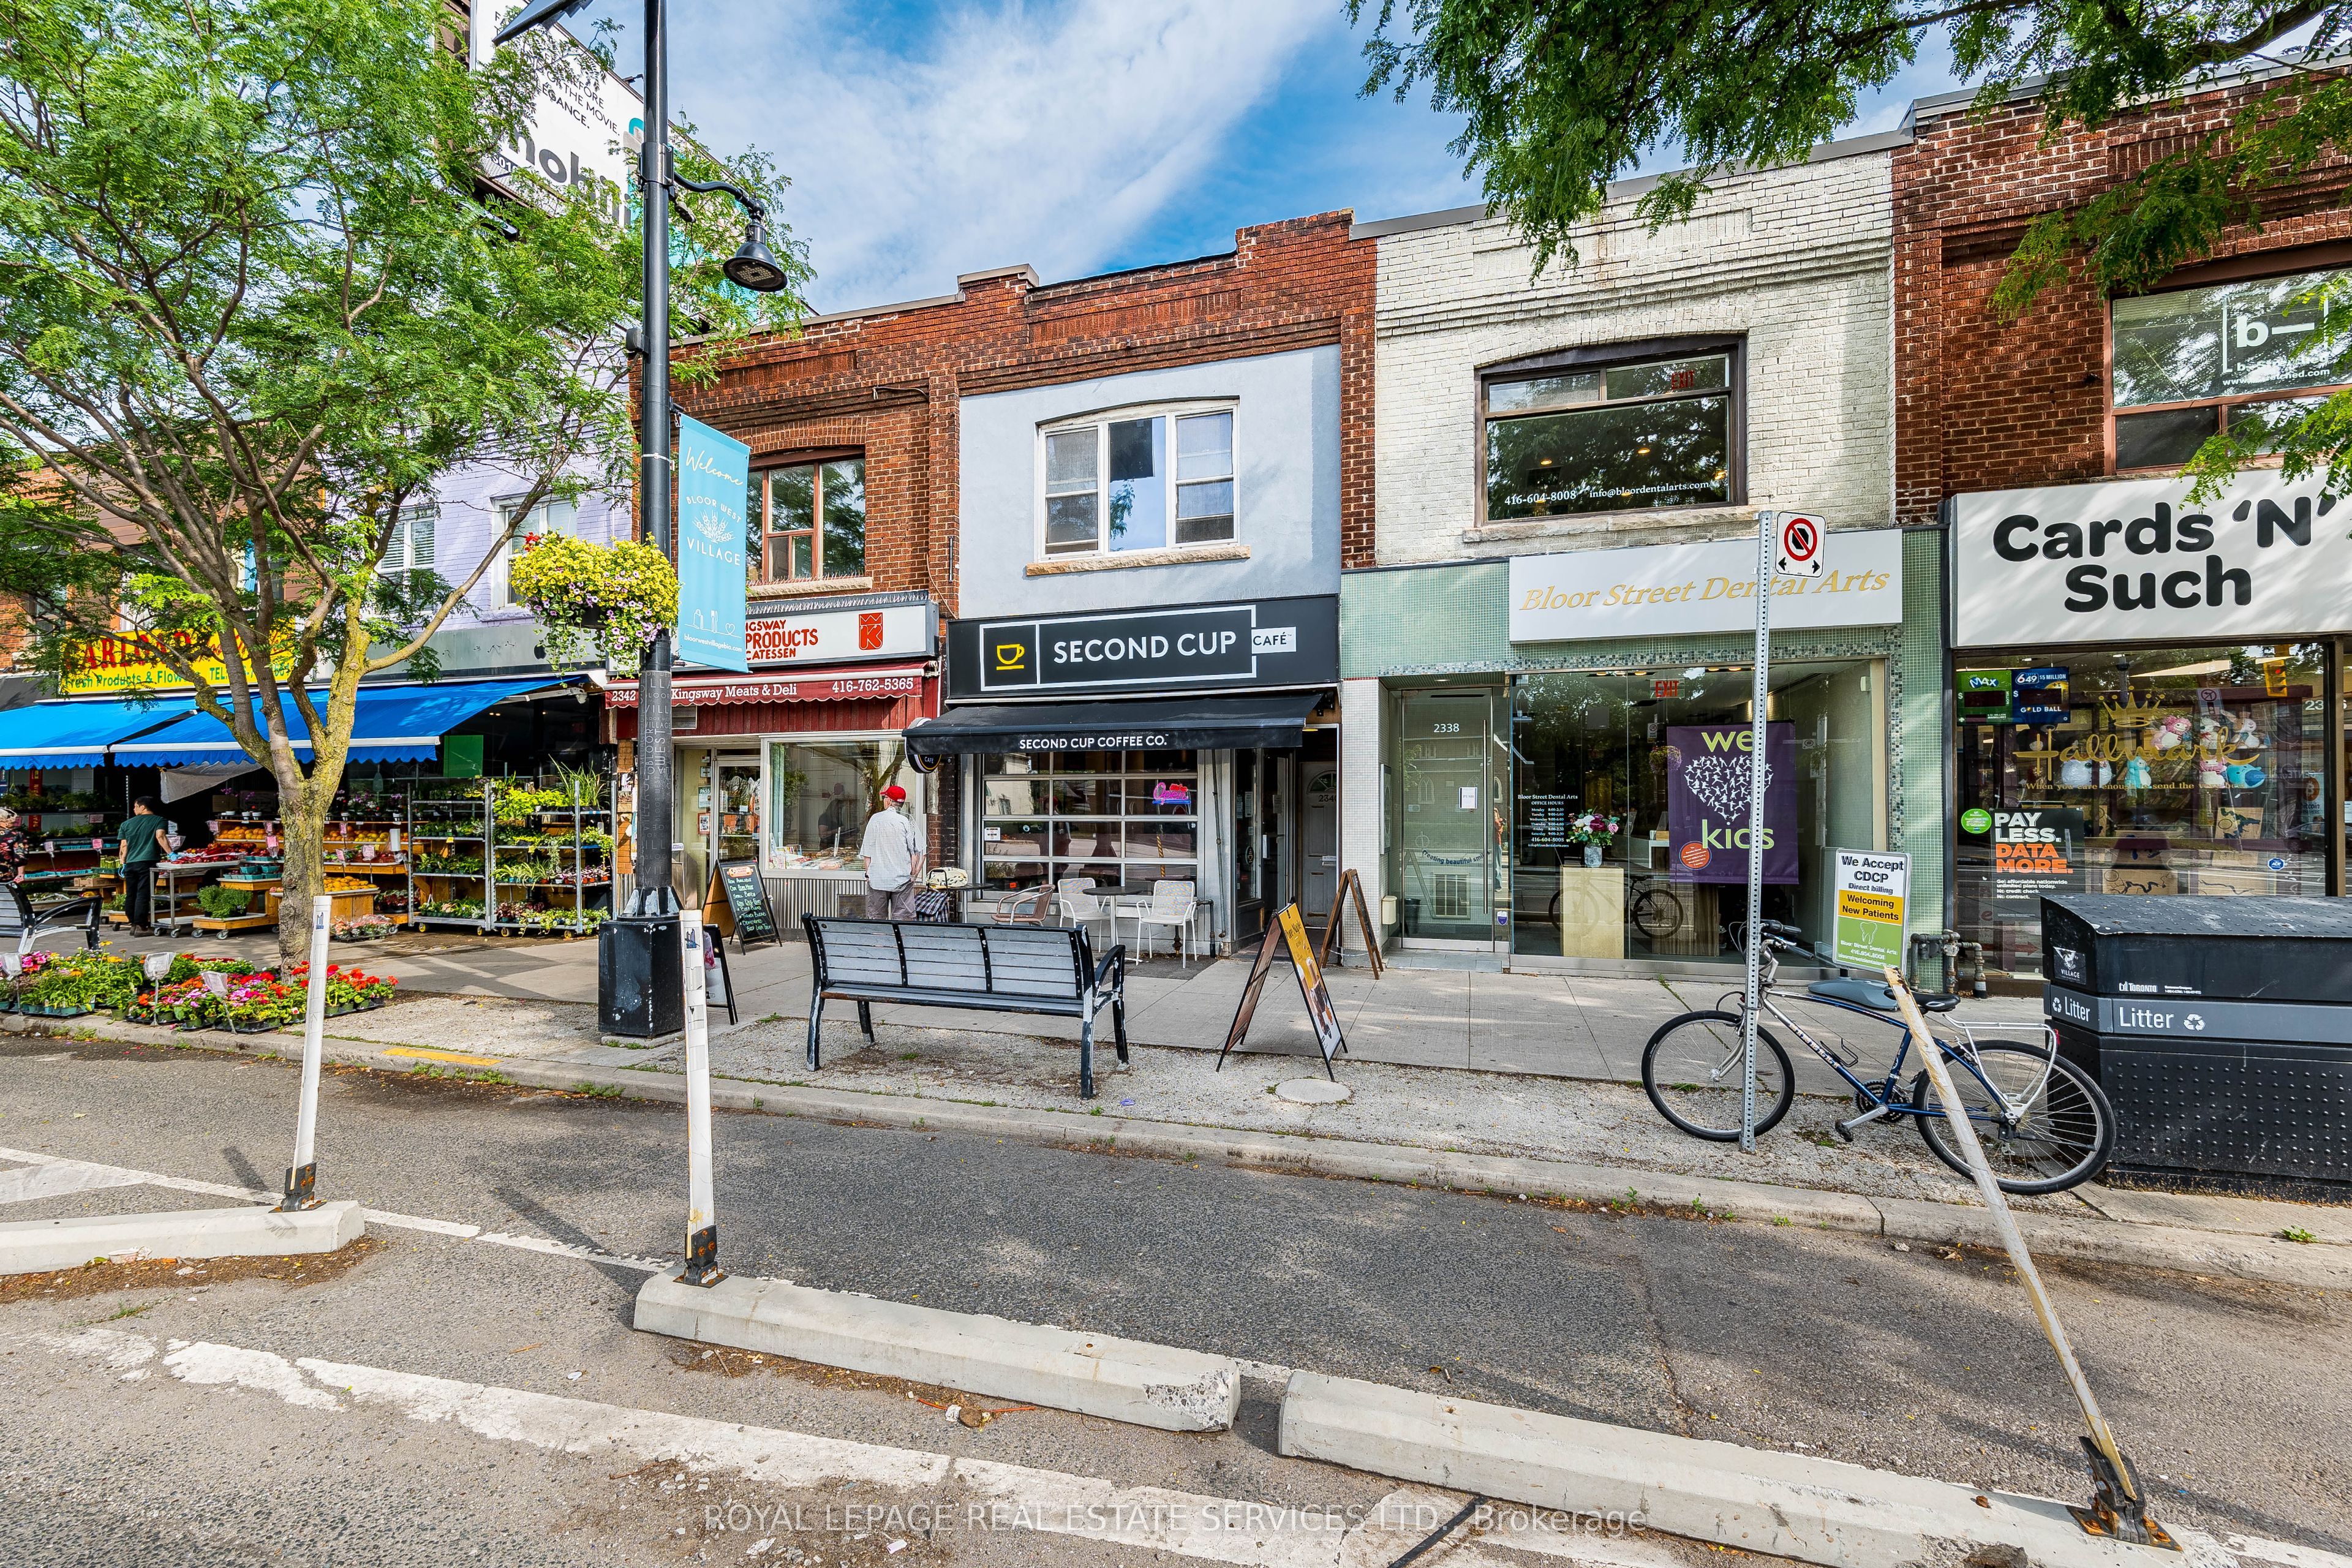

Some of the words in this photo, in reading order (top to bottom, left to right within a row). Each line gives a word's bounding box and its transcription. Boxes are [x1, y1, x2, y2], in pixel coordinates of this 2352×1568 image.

[570, 75, 604, 109] EFORE
[542, 83, 590, 129] EGANCE.
[564, 82, 583, 107] THE
[586, 102, 620, 136] MOVIE.
[1672, 370, 1695, 389] EXIT
[686, 447, 743, 486] Welcome
[1505, 489, 1577, 505] 416-604-8008
[1589, 481, 1709, 499] info@bloordentalarts.com
[686, 496, 717, 508] BLOOR
[720, 503, 742, 524] WEST
[1993, 502, 2214, 562] Cards
[687, 537, 741, 566] VILLAGE
[1519, 586, 1600, 611] Bloor
[1602, 580, 1697, 606] Street
[1811, 569, 1890, 594] Arts
[2064, 554, 2252, 612] Such
[746, 619, 786, 631] GSWAY
[684, 633, 742, 653] bloorwestvillagebia.com
[746, 628, 818, 650] PRODUCTS
[1054, 635, 1169, 663] SECOND
[1177, 631, 1237, 656] CUP
[97, 674, 141, 687] Products
[146, 671, 153, 682] &
[1655, 680, 1679, 698] EXIT
[1969, 677, 1997, 688] MAX
[612, 690, 636, 702] 2342
[671, 687, 723, 703] Kingsway
[725, 685, 760, 698] Meats
[762, 685, 771, 696] &
[773, 683, 797, 696] Deli
[832, 677, 914, 693] 416-762-5365
[1433, 723, 1460, 734] 2338
[1020, 737, 1068, 749] SECOND
[1071, 737, 1095, 748] CUP
[1098, 736, 1143, 747] COFFEE
[1145, 735, 1167, 746] CO.
[1702, 731, 1754, 752] we
[2013, 726, 2260, 782] Hallmark
[1153, 782, 1188, 805] Open
[1994, 812, 2042, 827] PAY
[1995, 827, 2061, 842] LESS.
[1996, 843, 2059, 858] DATA
[1841, 856, 1858, 866] We
[1861, 858, 1904, 872] Accept
[1996, 859, 2073, 873] MORE.
[1854, 870, 1888, 883] CDCP
[1849, 883, 1869, 891] Direct
[1871, 885, 1893, 895] billing
[1847, 894, 1894, 909] Welcoming
[1842, 905, 1860, 914] New
[1863, 908, 1899, 921] Patients
[2060, 968, 2080, 979] VILLAGE
[2064, 996, 2090, 1022] Litter
[2119, 1006, 2175, 1029] Litter
